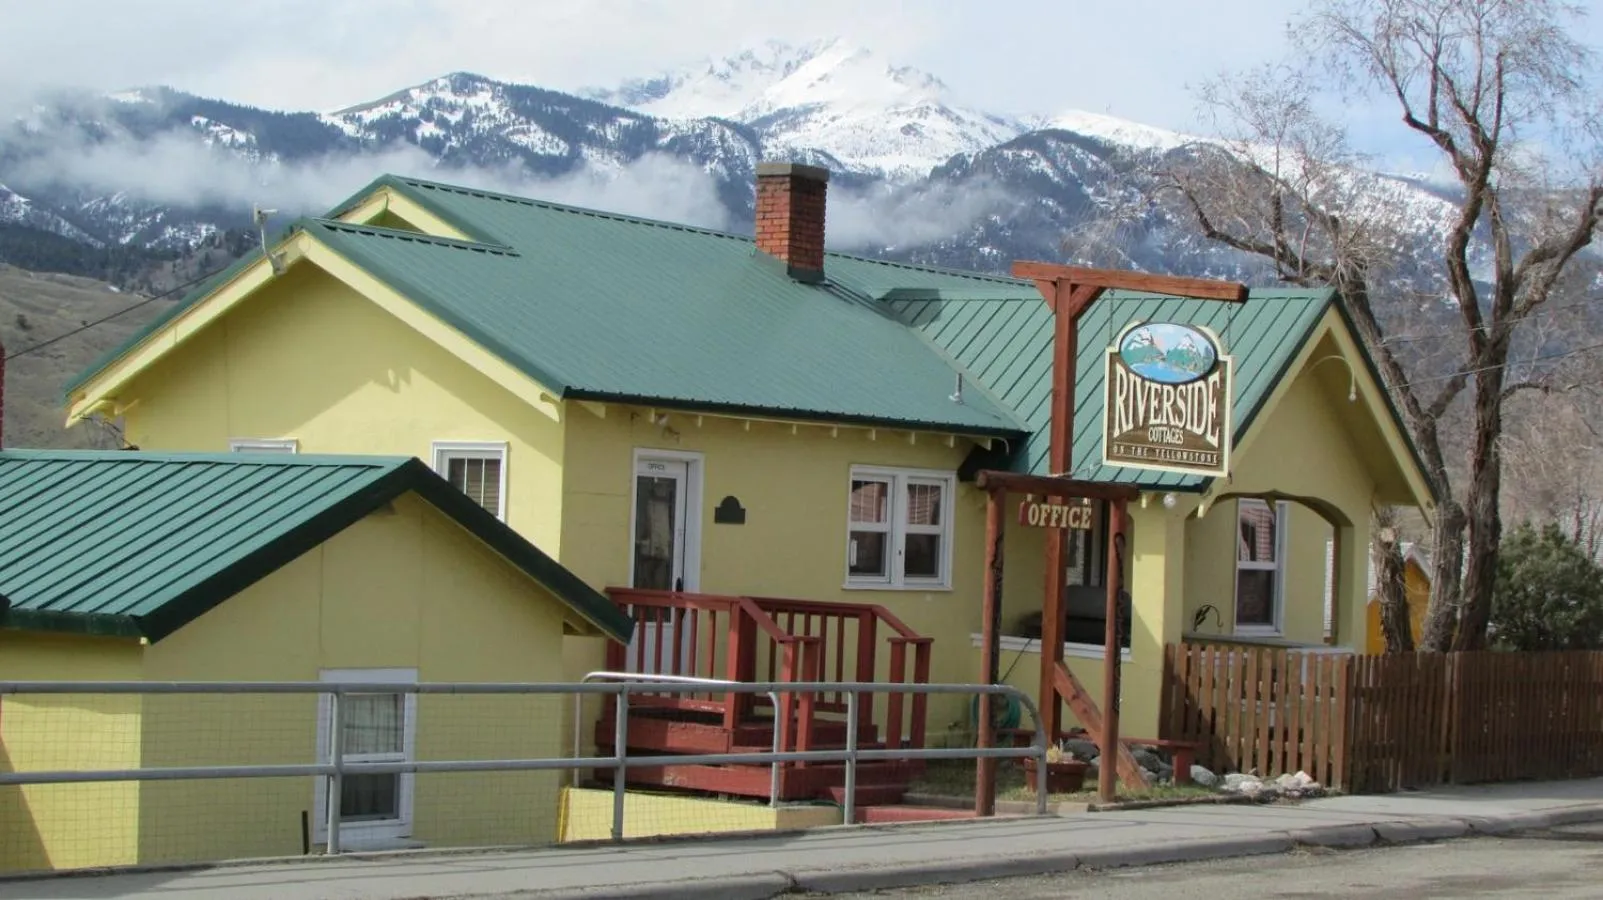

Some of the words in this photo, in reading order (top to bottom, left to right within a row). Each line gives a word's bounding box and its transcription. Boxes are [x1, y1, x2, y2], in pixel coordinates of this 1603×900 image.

[1113, 362, 1220, 448] RIVERSIDE
[1148, 426, 1184, 444] COTTAGES
[1113, 444, 1125, 454] ON
[1131, 446, 1148, 456] THE
[1155, 448, 1217, 464] YELLOWSTONE
[1028, 503, 1092, 529] OFFICE
